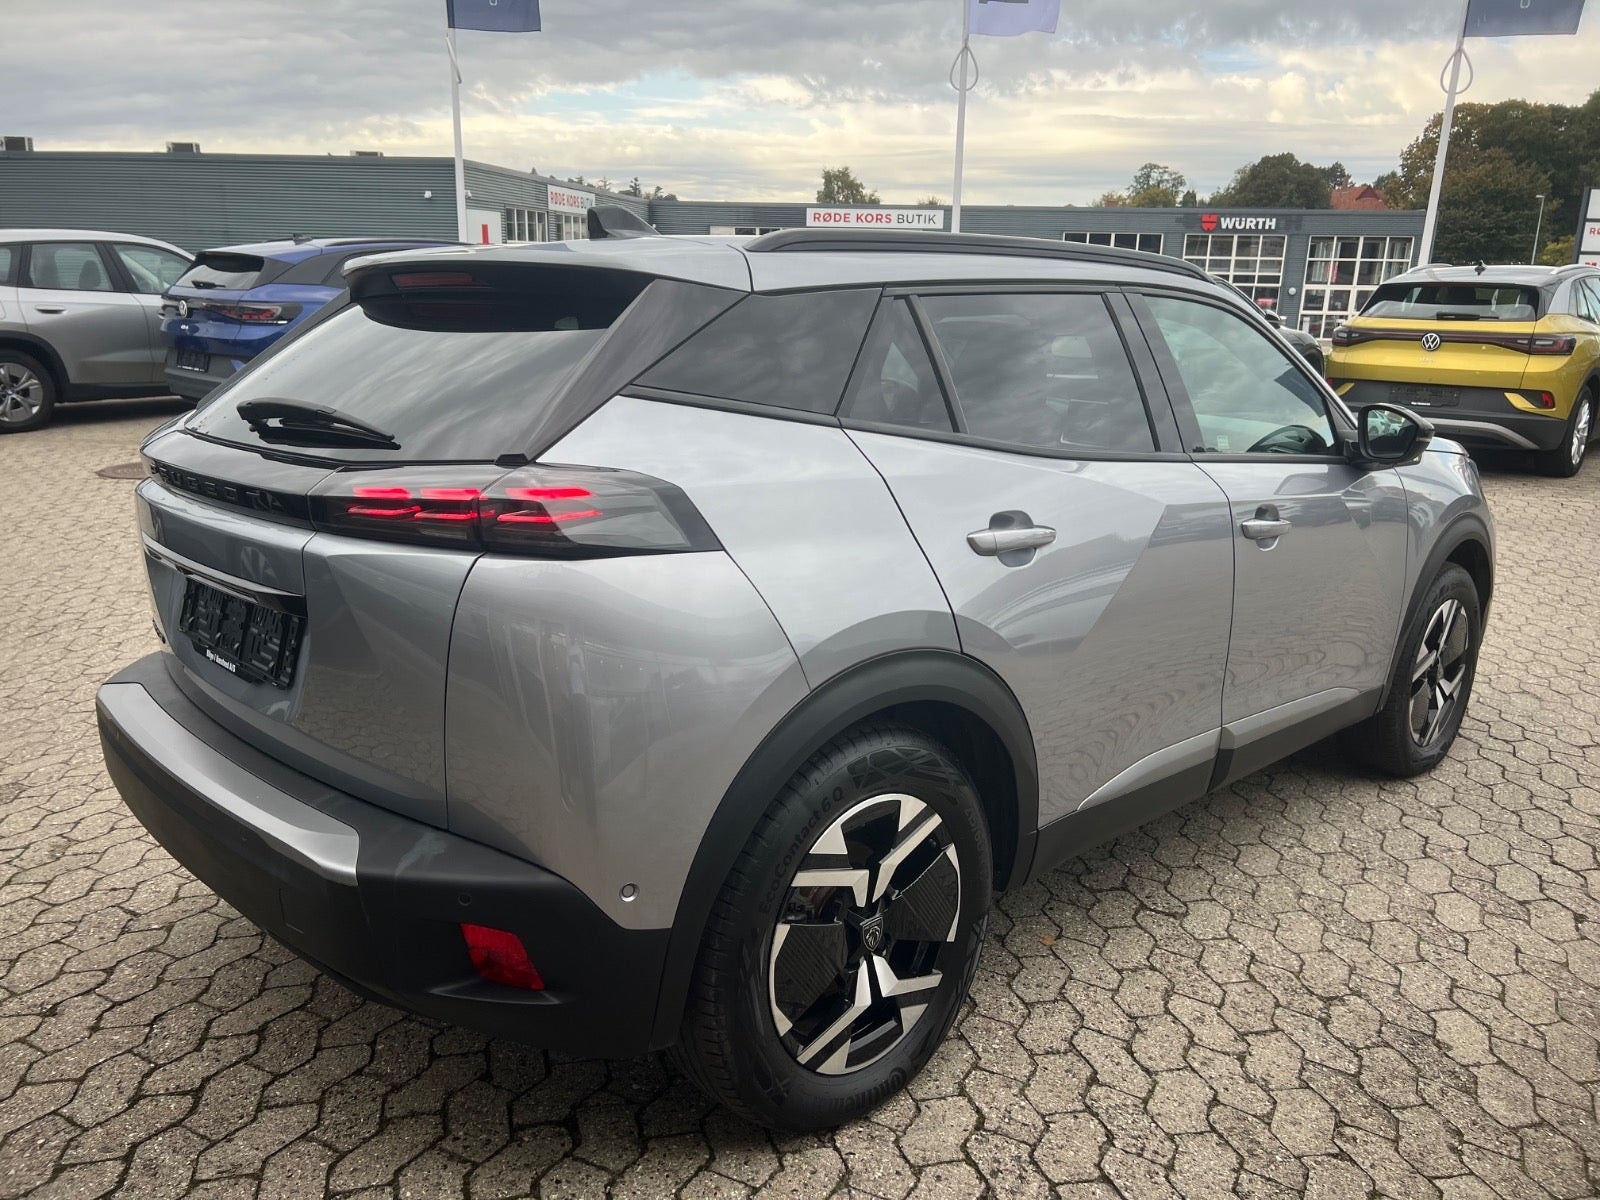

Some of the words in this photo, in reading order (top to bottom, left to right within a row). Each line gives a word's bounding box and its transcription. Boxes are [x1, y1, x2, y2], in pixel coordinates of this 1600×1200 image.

[813, 212, 851, 223] RØDE
[856, 213, 892, 224] KORS
[897, 214, 936, 225] BUTIK
[1220, 217, 1277, 230] WÜRTH
